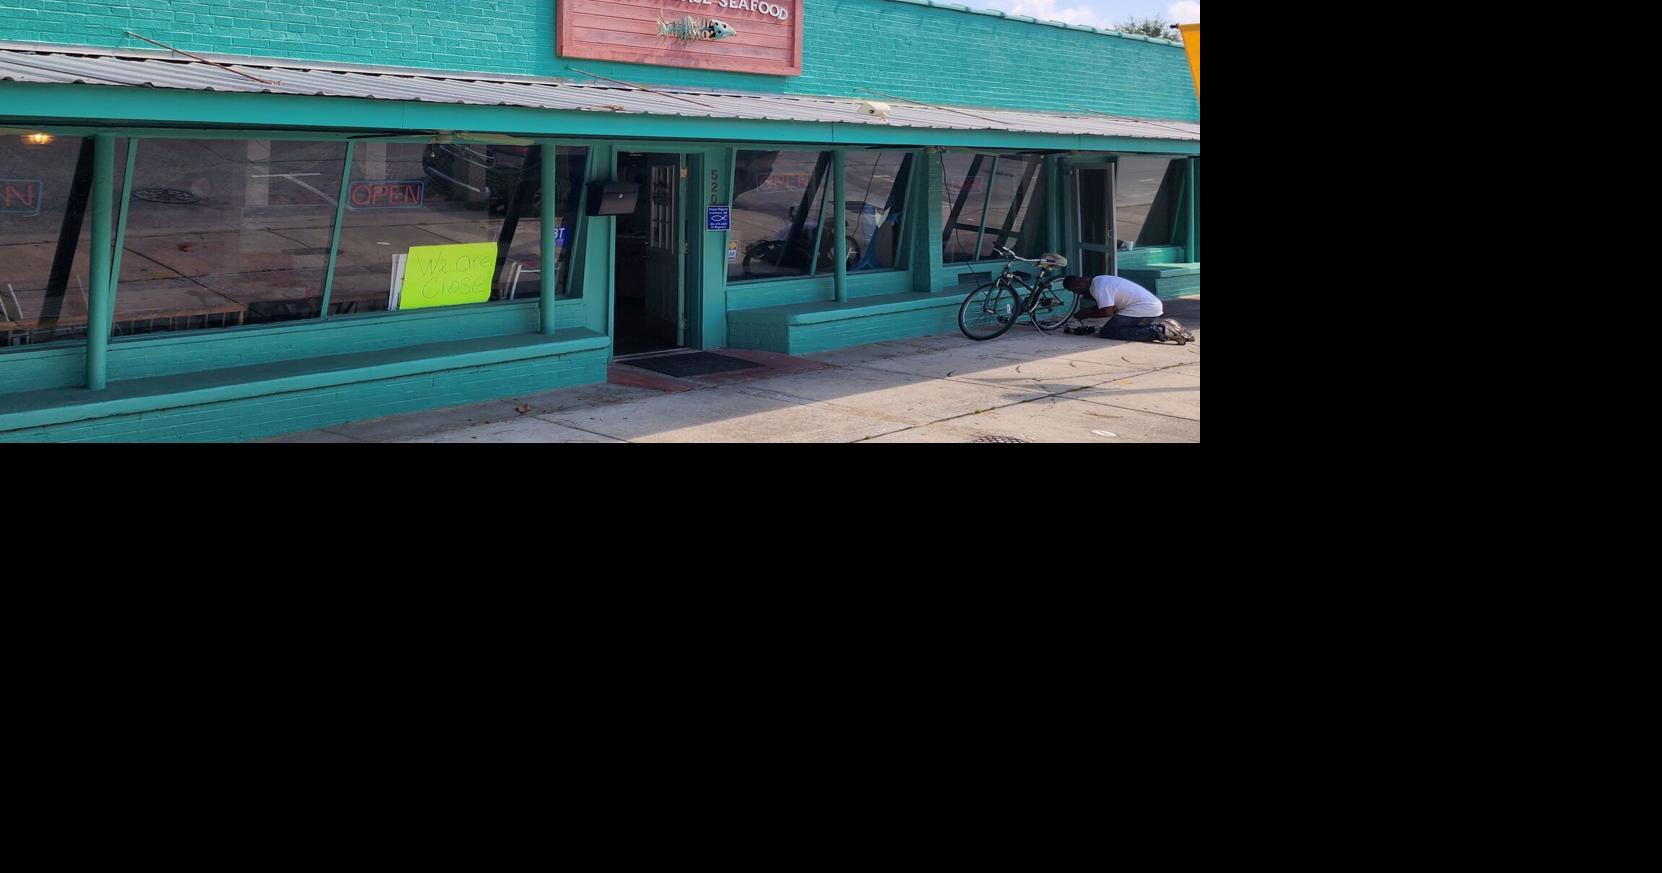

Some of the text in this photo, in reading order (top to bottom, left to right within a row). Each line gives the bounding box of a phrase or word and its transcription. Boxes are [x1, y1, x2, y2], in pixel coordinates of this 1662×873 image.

[719, 0, 788, 20] SEAFOOD
[351, 184, 421, 206] OPEN
[416, 250, 491, 277] We are
